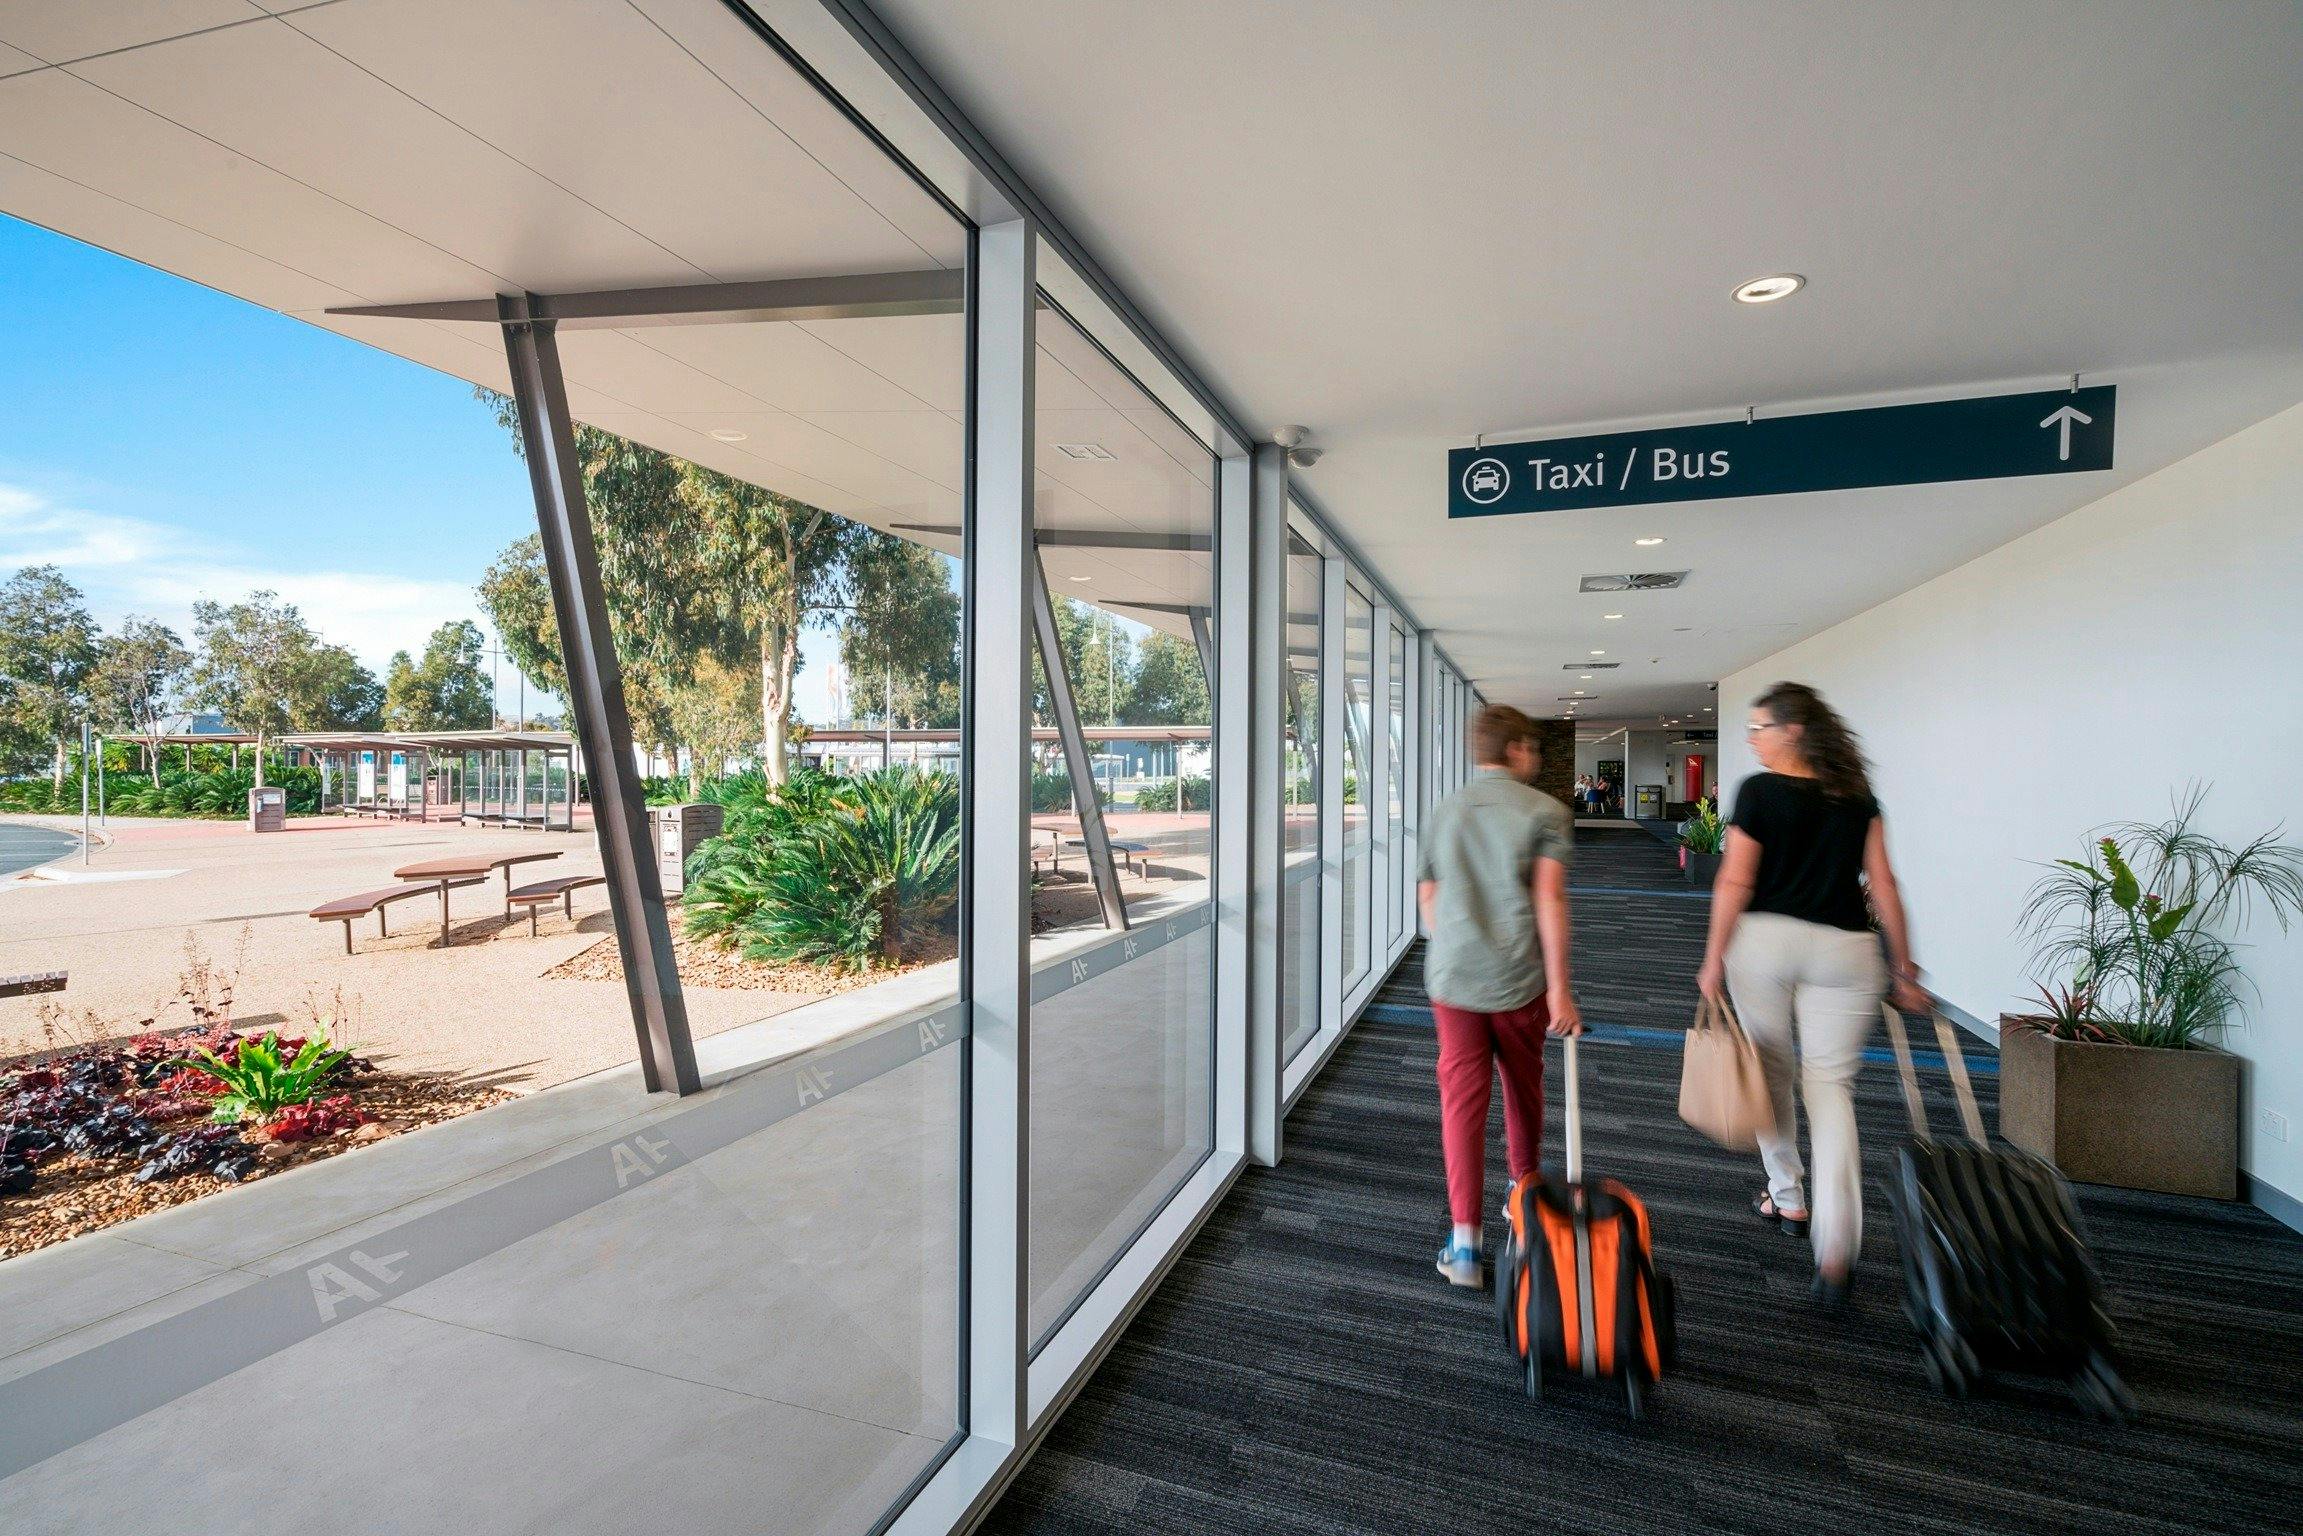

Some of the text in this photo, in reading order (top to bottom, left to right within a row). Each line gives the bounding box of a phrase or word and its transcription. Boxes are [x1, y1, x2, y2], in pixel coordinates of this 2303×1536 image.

[1528, 447, 1730, 491] Taxi / Bus
